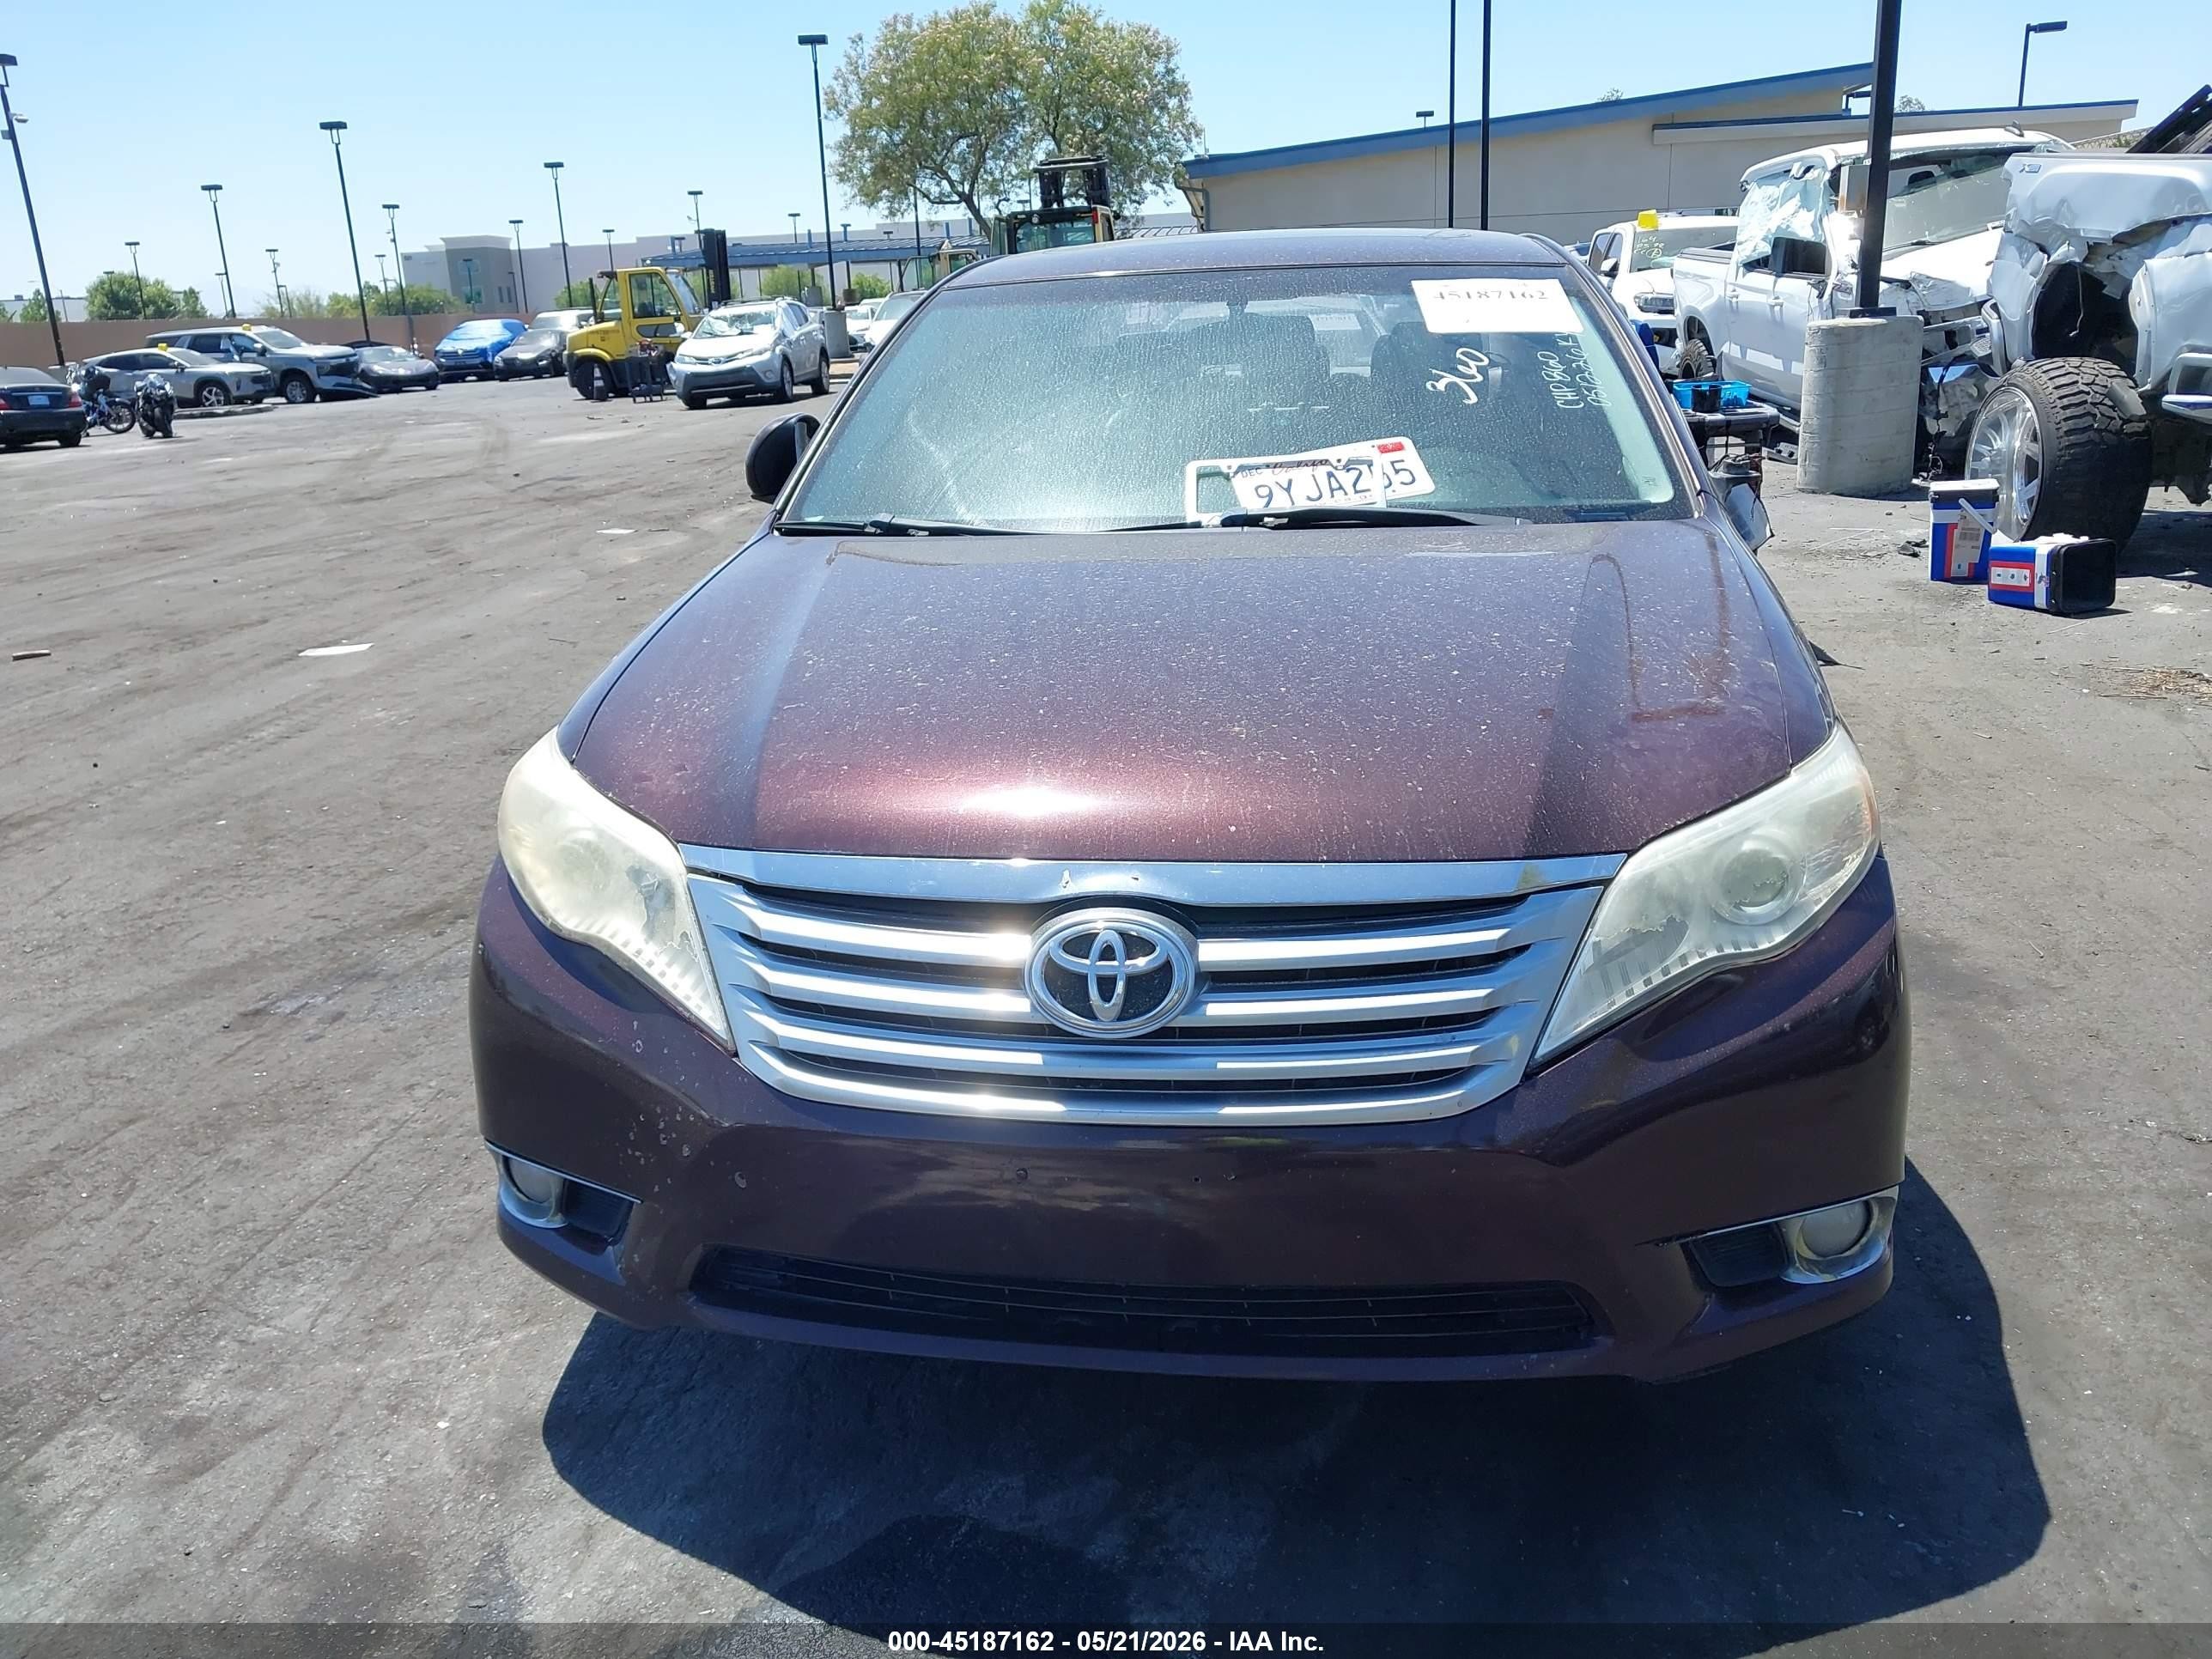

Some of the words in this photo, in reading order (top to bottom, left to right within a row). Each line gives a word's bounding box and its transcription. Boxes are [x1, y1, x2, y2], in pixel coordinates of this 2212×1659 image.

[1425, 347, 1490, 404] 360
[1537, 350, 1571, 381] 860
[1549, 383, 1584, 409] CHP
